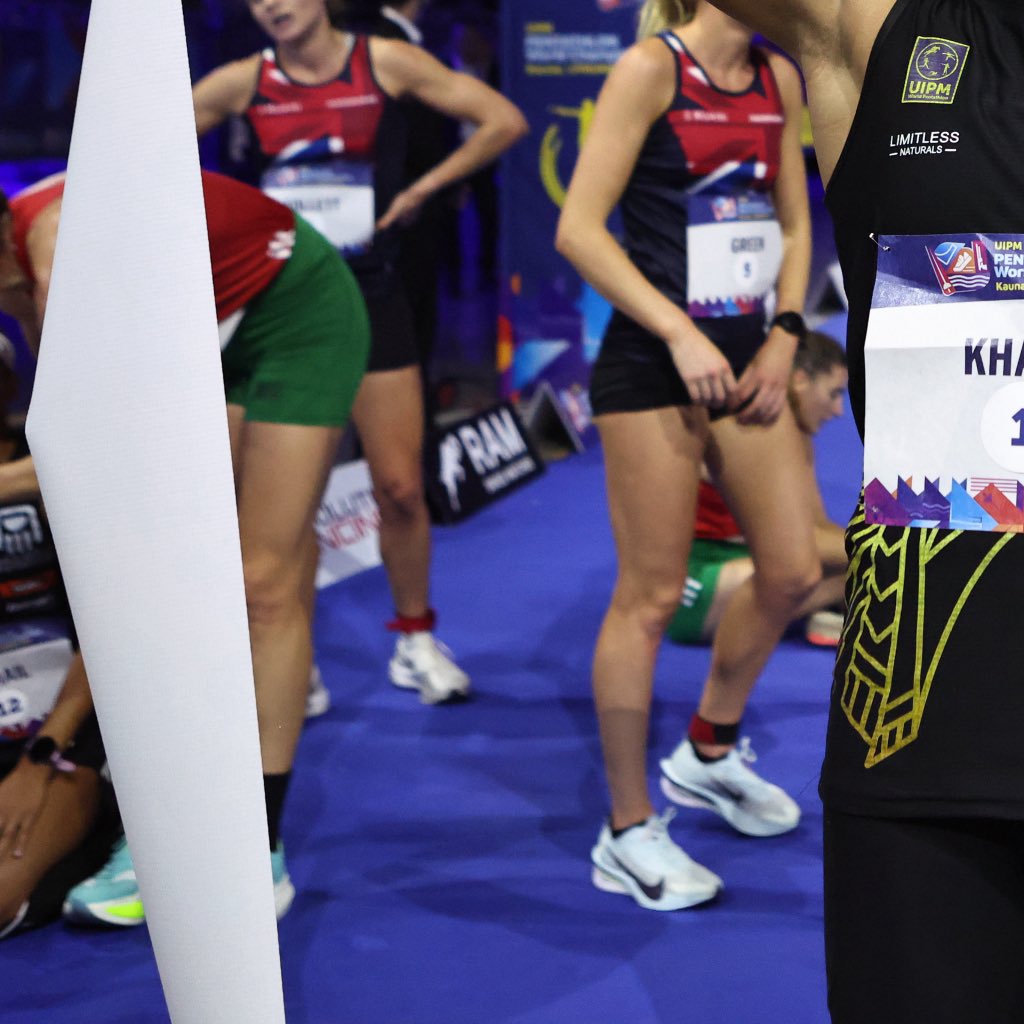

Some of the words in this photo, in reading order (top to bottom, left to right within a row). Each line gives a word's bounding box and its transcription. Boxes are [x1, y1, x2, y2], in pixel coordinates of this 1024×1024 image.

[909, 81, 952, 95] UIPM
[889, 131, 960, 147] LIMITLESS
[899, 145, 943, 156] NATURALS
[994, 241, 1022, 251] UIPM
